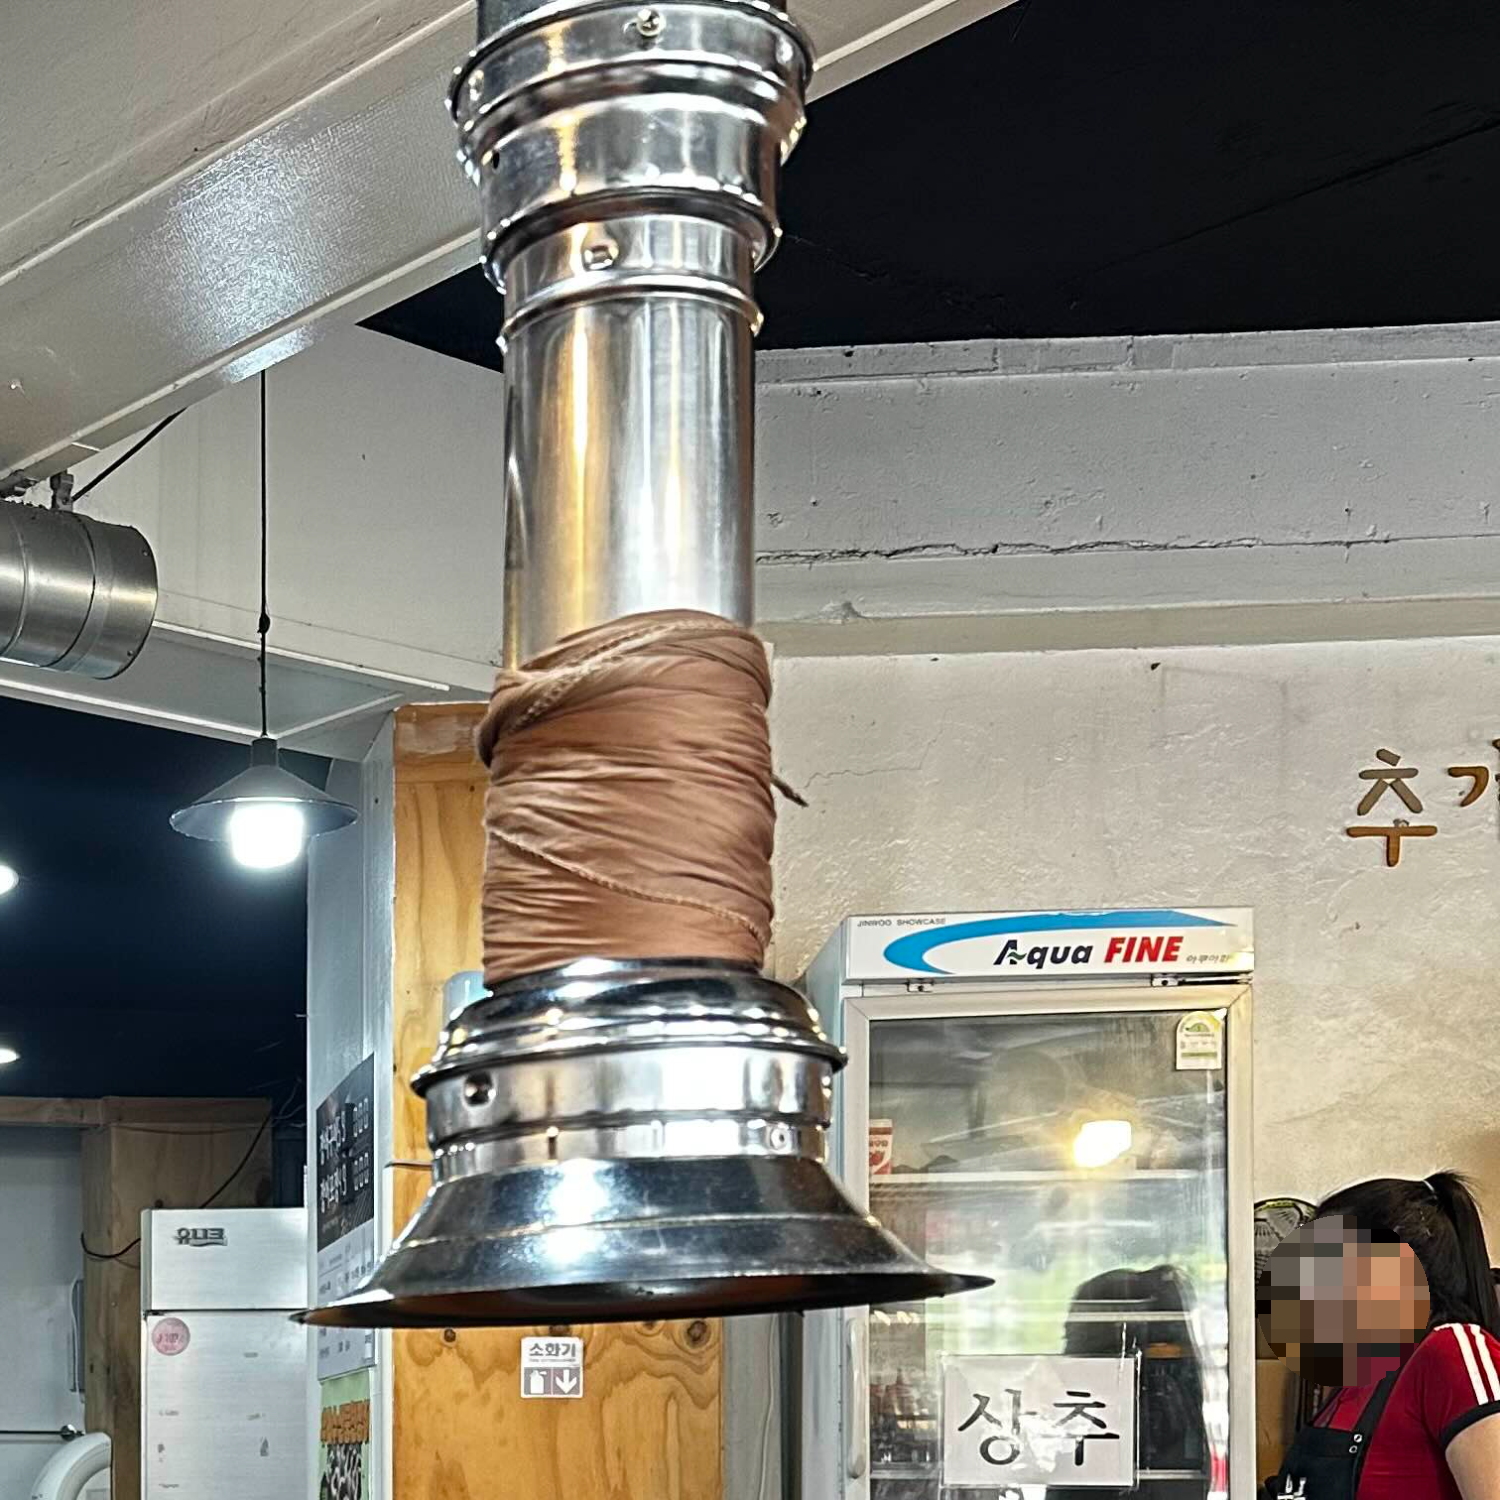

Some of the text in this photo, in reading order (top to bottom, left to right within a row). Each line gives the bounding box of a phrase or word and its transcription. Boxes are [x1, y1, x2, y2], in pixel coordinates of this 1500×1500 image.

[993, 935, 1185, 969] Aqua FINE
[175, 1226, 228, 1247] 유니크
[529, 1342, 577, 1358] 소화기
[957, 1388, 1121, 1467] 상추
